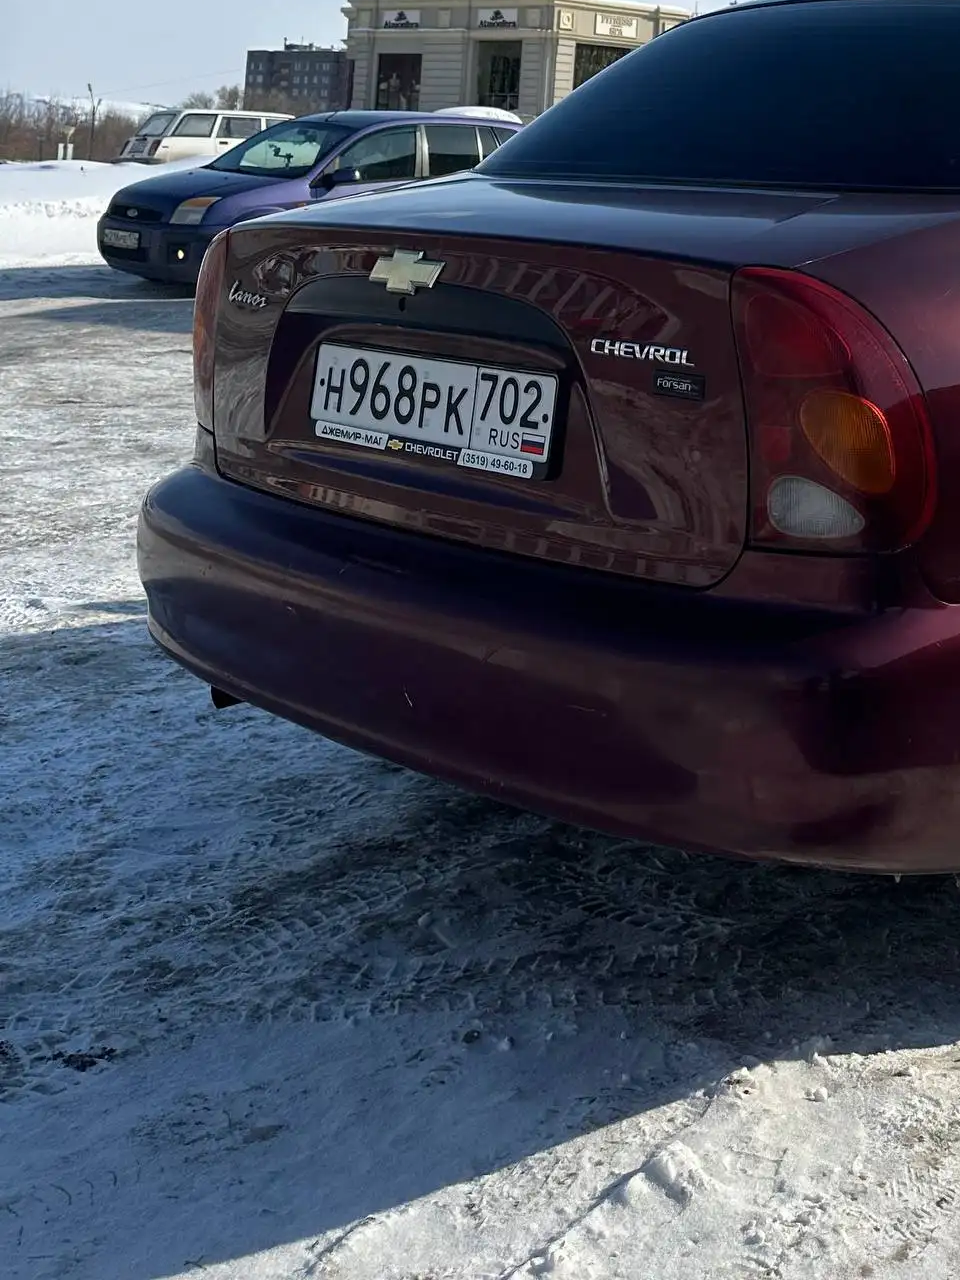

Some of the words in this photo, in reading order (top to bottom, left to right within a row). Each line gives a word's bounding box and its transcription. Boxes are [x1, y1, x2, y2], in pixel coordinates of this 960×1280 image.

[228, 280, 267, 308] Lanos
[590, 338, 695, 367] CHEVROL
[657, 377, 692, 392] Forsan
[480, 372, 543, 430] 702
[488, 428, 520, 450] RUS
[404, 442, 459, 461] CHEVROLET
[462, 452, 489, 469] (3519)
[490, 458, 529, 474] 49-60-18
